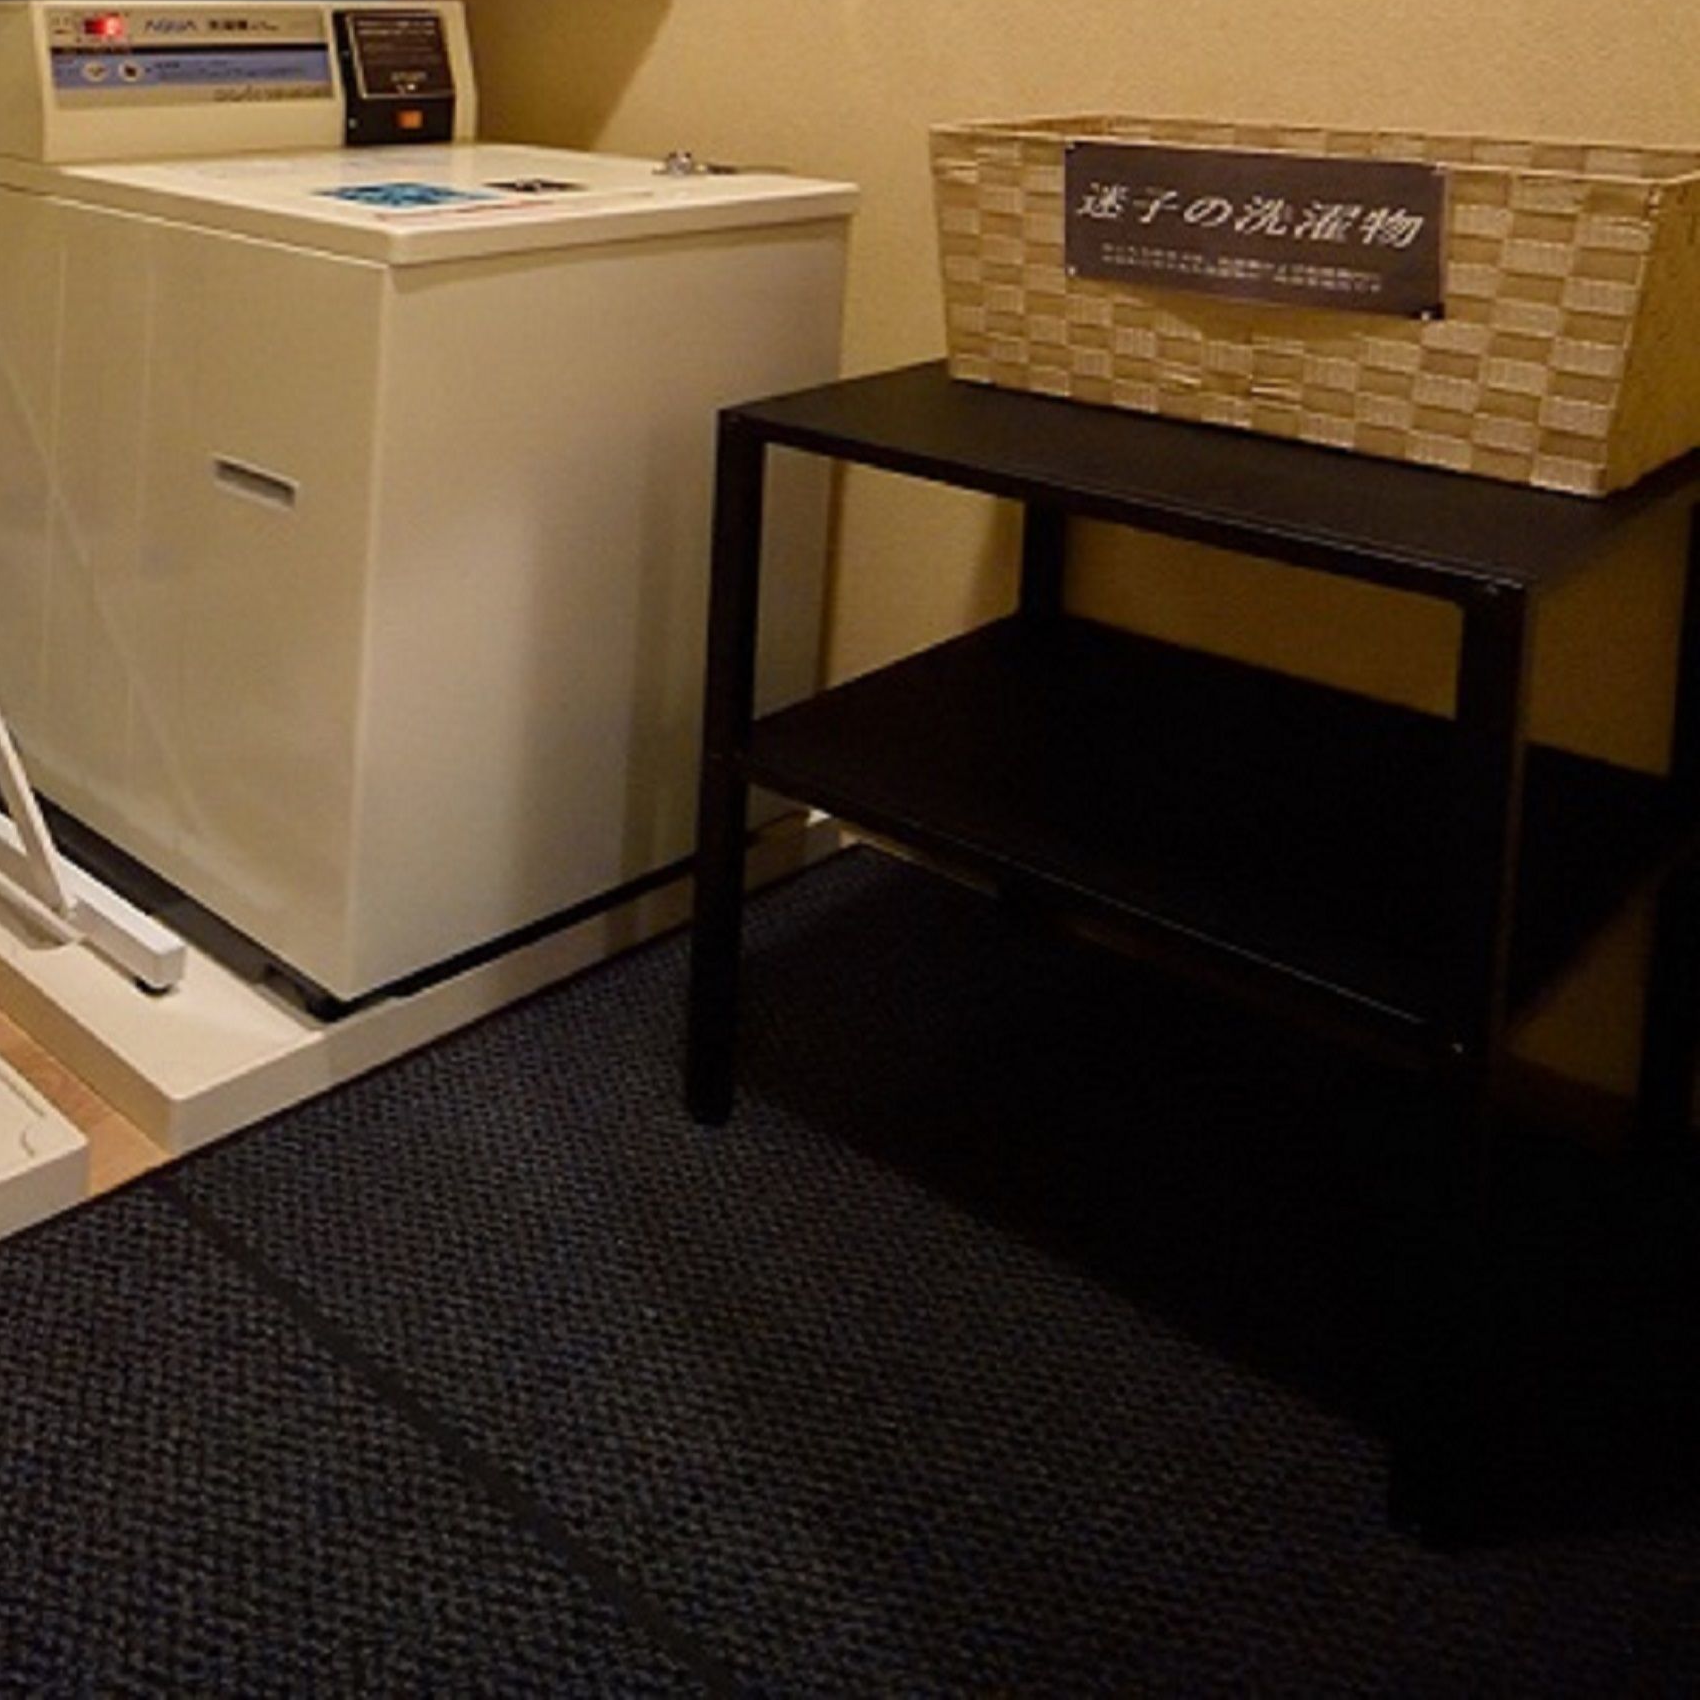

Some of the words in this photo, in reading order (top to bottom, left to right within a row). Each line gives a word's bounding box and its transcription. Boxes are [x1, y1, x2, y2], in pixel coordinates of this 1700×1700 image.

[1075, 181, 1425, 249] 迷子の洗濯物
